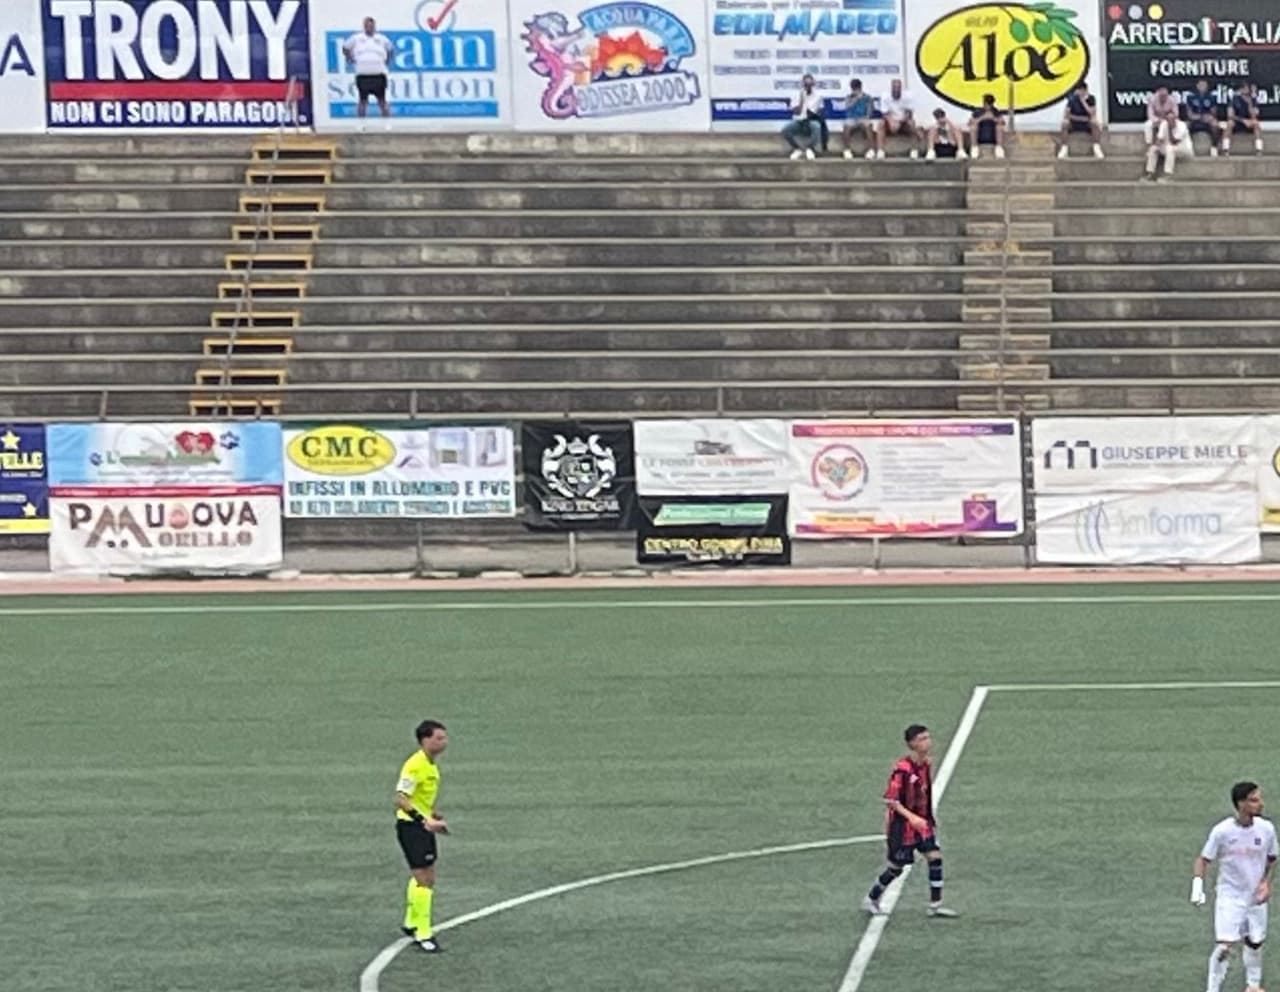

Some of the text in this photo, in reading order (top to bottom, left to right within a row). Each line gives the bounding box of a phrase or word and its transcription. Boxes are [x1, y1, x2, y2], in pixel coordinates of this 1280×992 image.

[50, 0, 300, 81] TRONY
[935, 33, 1071, 82] Aloe
[1150, 58, 1250, 77] FORNITURE
[51, 101, 95, 124] NON
[101, 101, 125, 124] CI
[127, 101, 186, 124] SONO
[301, 436, 379, 459] CMC
[1101, 445, 1248, 461] GIUSEPPE MIELE
[288, 480, 511, 496] INFISSI IN ALLUMINIO E PVC
